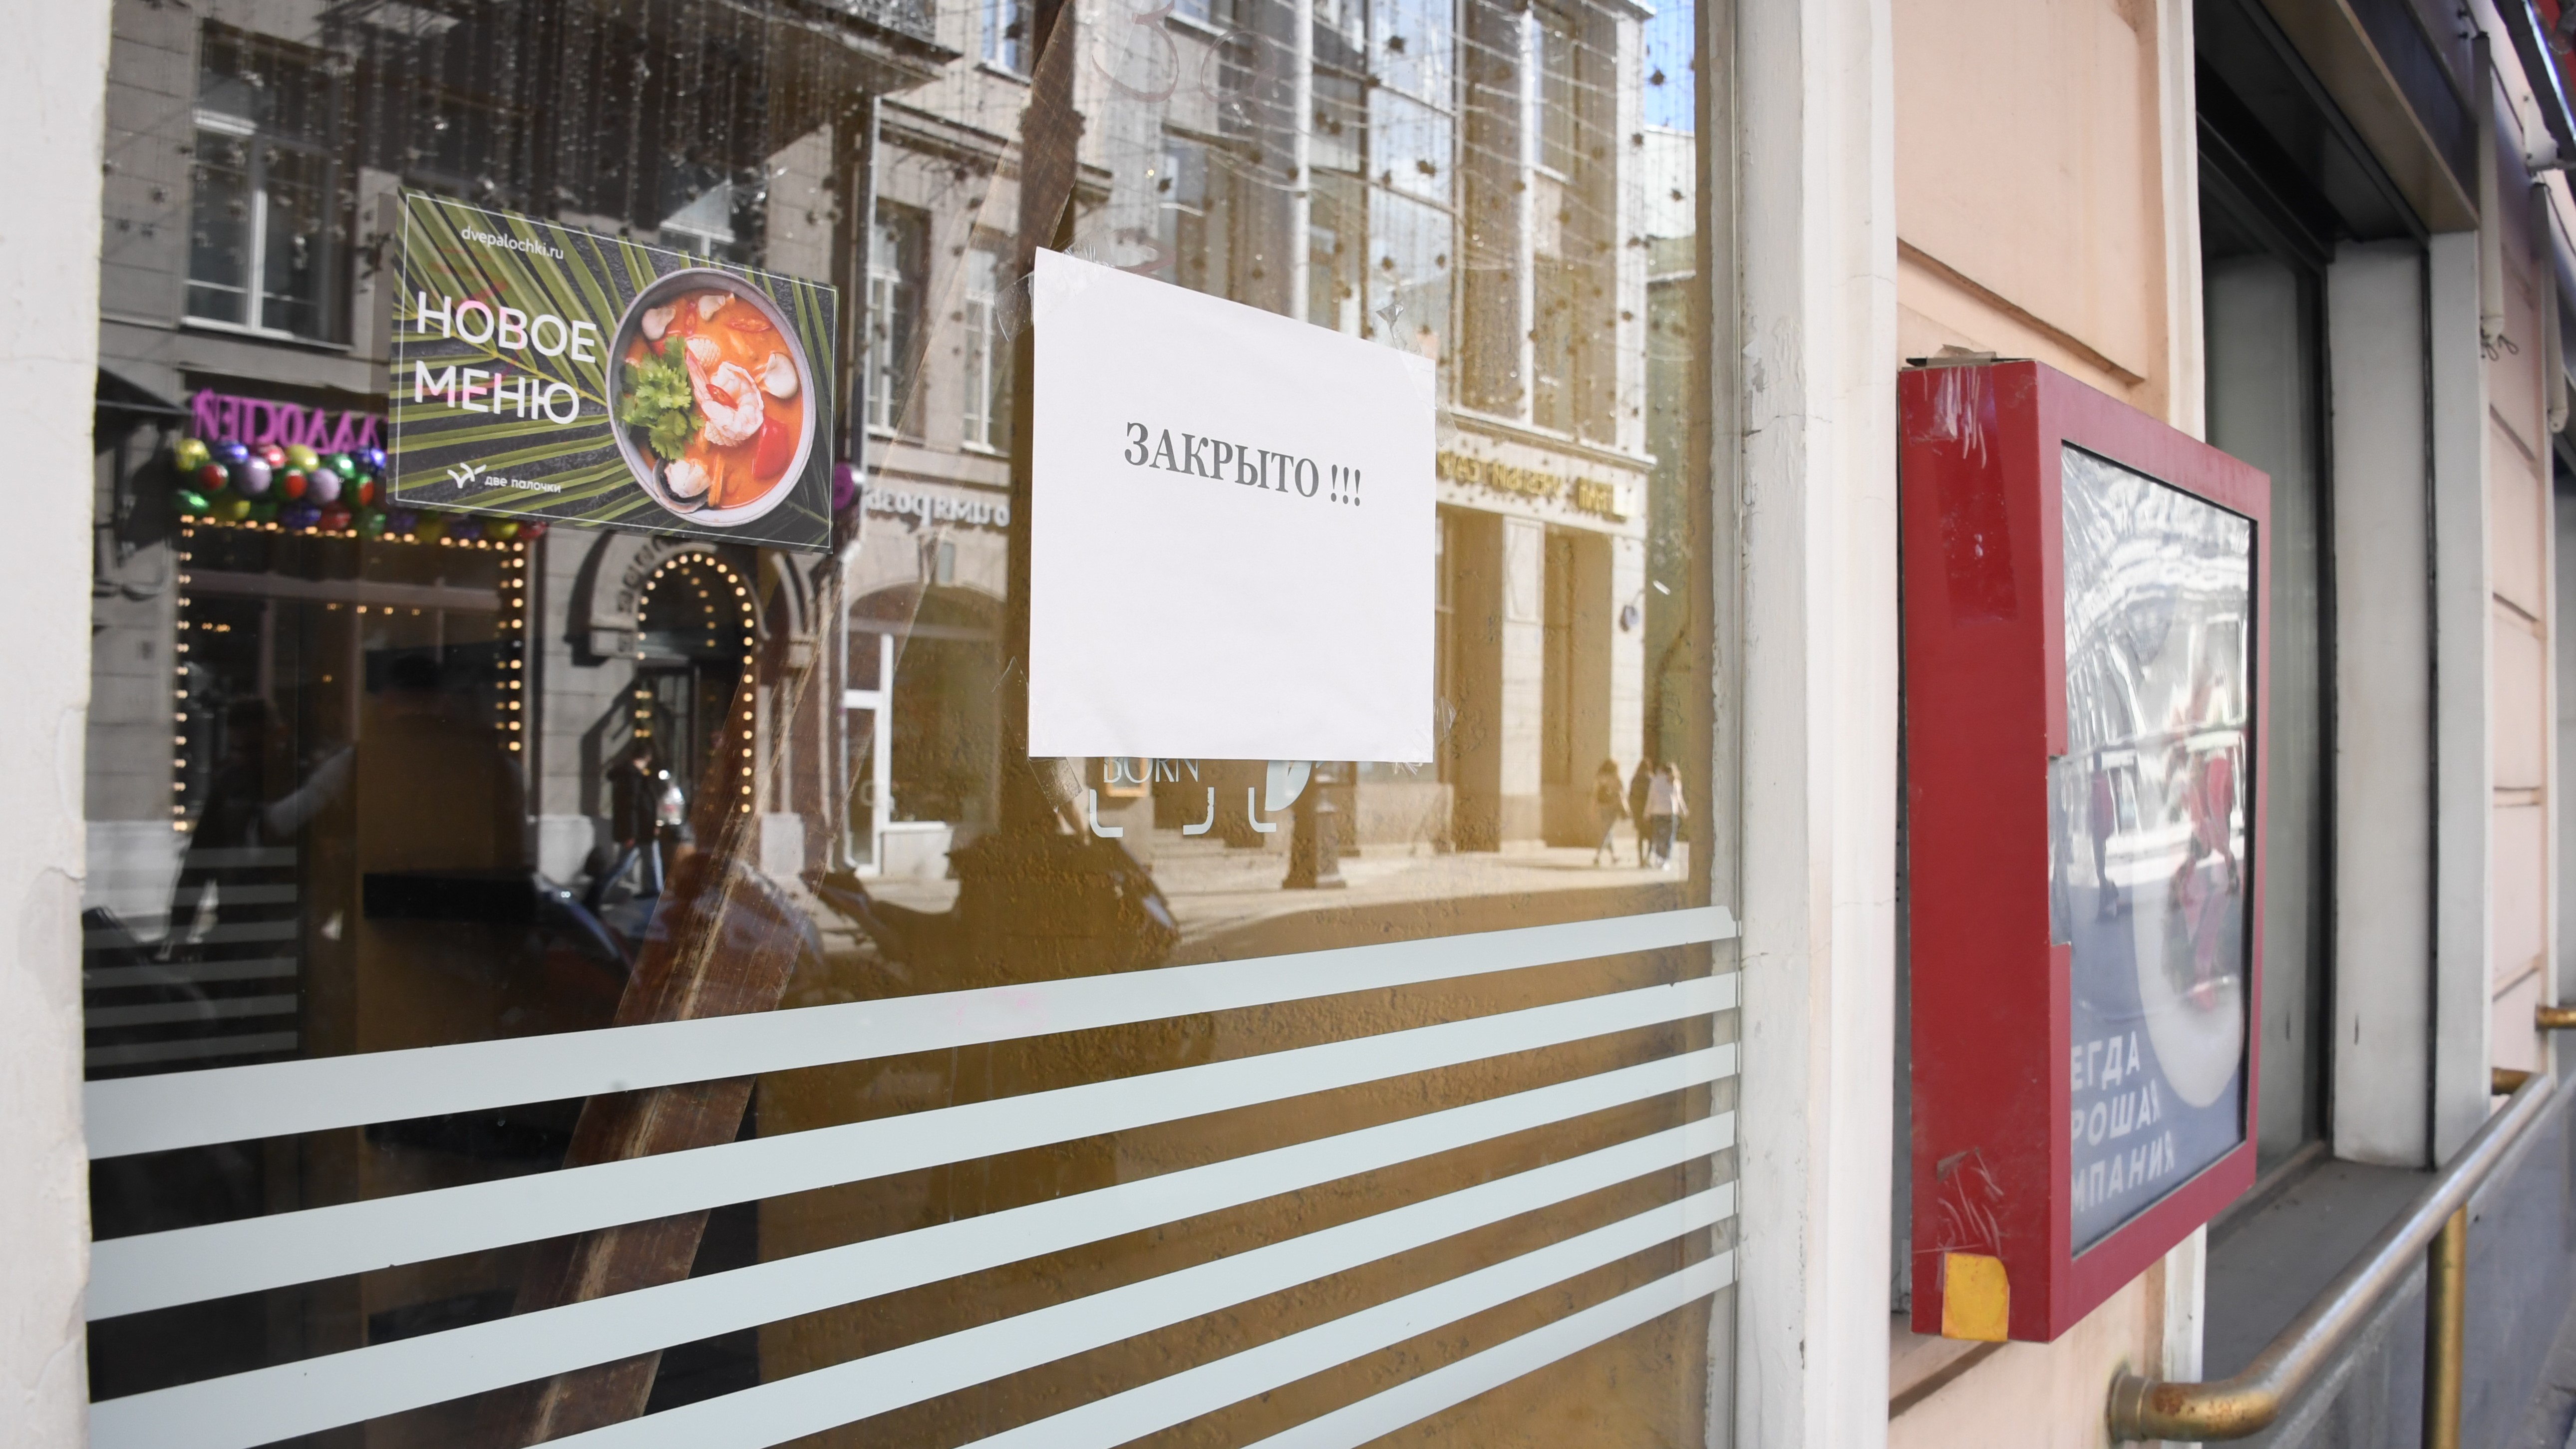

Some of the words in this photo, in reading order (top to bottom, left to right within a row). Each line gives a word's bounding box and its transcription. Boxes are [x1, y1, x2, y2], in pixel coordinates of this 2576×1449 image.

[461, 226, 564, 260] dvepalochki.ru
[417, 291, 597, 363] НОВОЕ
[414, 360, 580, 424] МЕНЮ
[485, 476, 508, 487] две
[512, 479, 561, 493] палочки
[1124, 421, 1319, 498] ЗАКРЫТО
[1330, 464, 1361, 507] !!!
